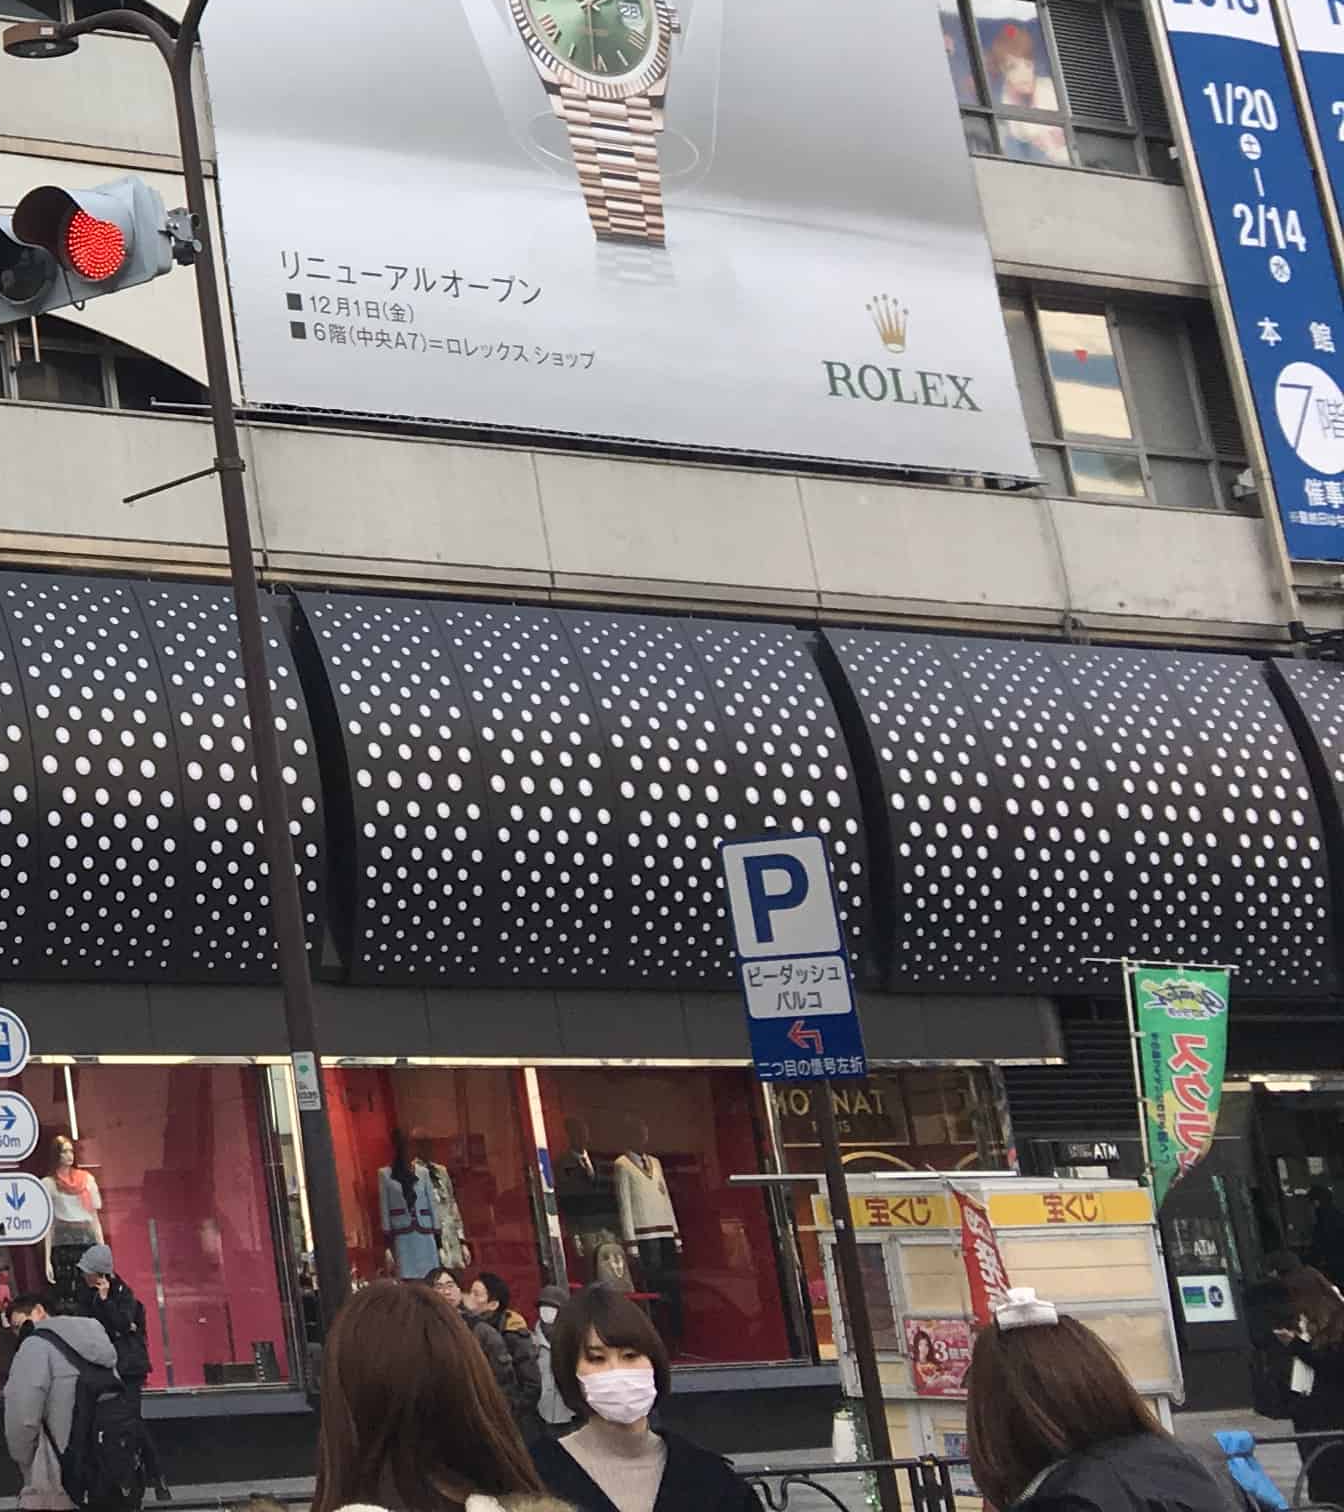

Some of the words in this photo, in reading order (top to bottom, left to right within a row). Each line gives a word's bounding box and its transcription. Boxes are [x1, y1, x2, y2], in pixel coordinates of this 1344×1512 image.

[1202, 81, 1279, 131] 1/20
[1233, 202, 1307, 252] 2/14
[279, 249, 543, 305] リニューアルオープン
[823, 360, 982, 413] ROLEX
[742, 853, 810, 945] P
[758, 1054, 865, 1079] 二つ目の信号左折
[1093, 1142, 1121, 1161] ATM
[865, 1197, 932, 1226] 宝くじ
[1042, 1192, 1099, 1224] 宝くじ
